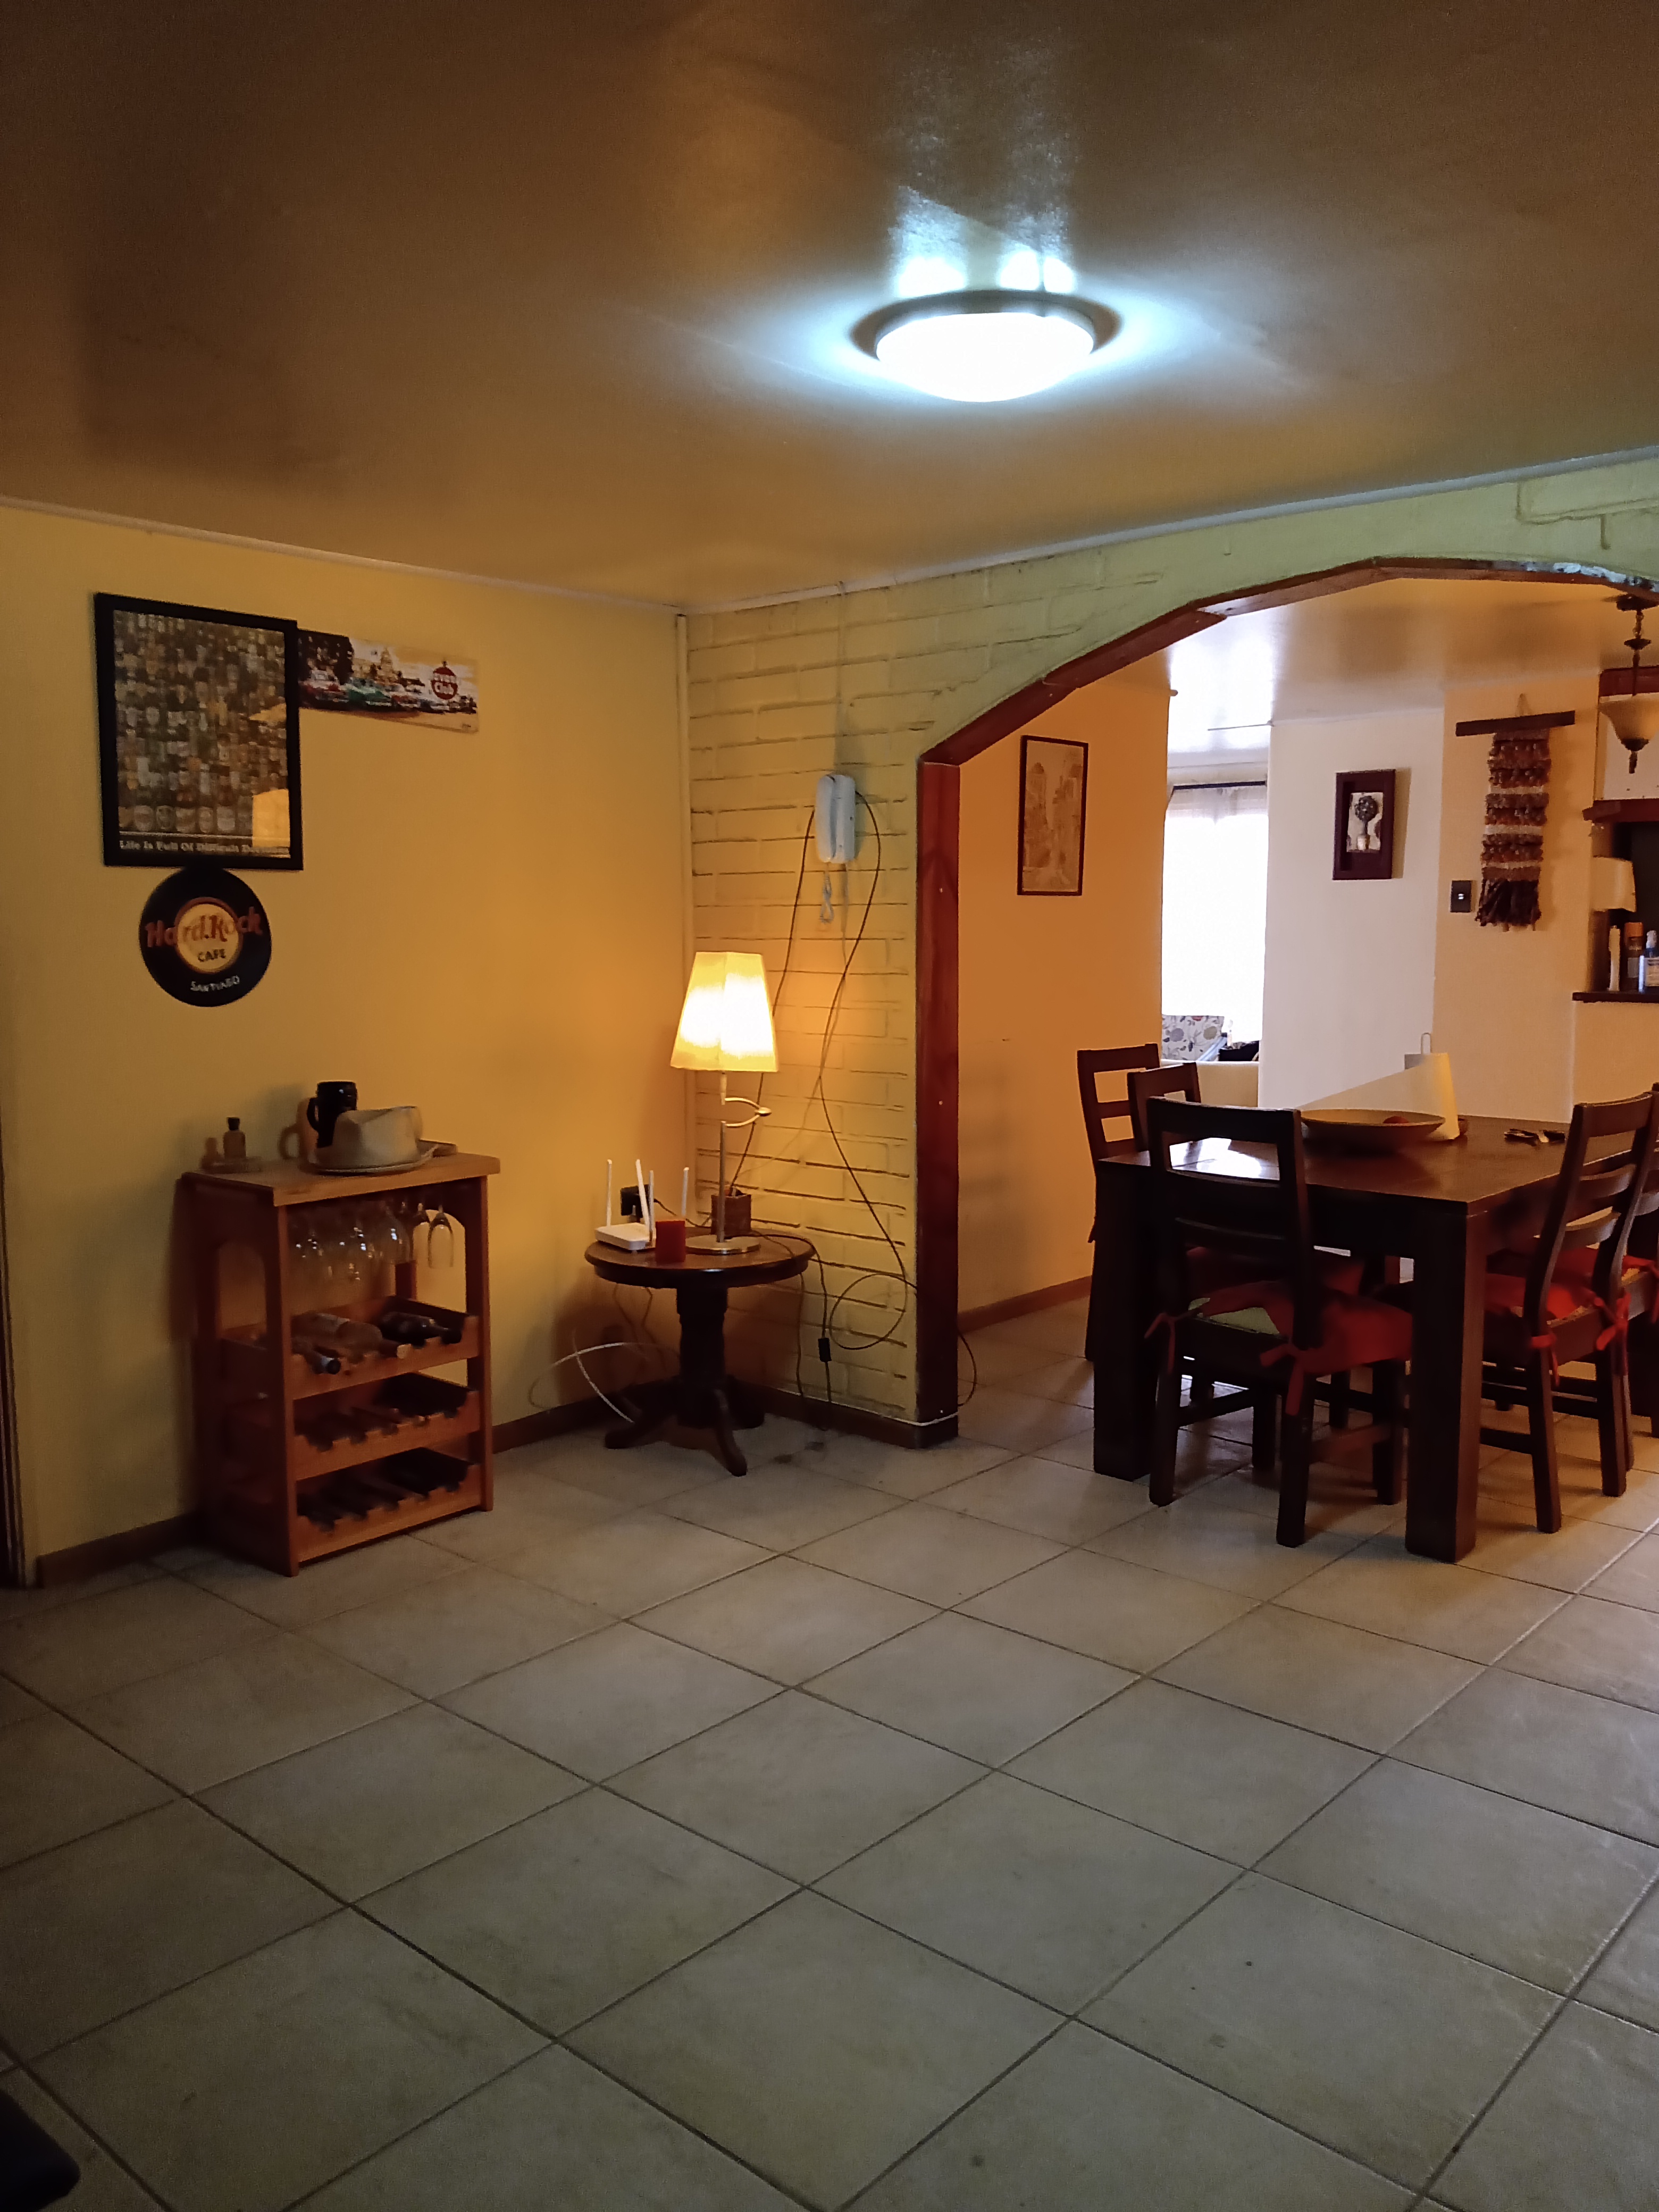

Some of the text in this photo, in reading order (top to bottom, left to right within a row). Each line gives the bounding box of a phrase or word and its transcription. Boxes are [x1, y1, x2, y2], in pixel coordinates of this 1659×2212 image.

[145, 906, 263, 948] Hard Rock
[197, 949, 226, 962] CAFE
